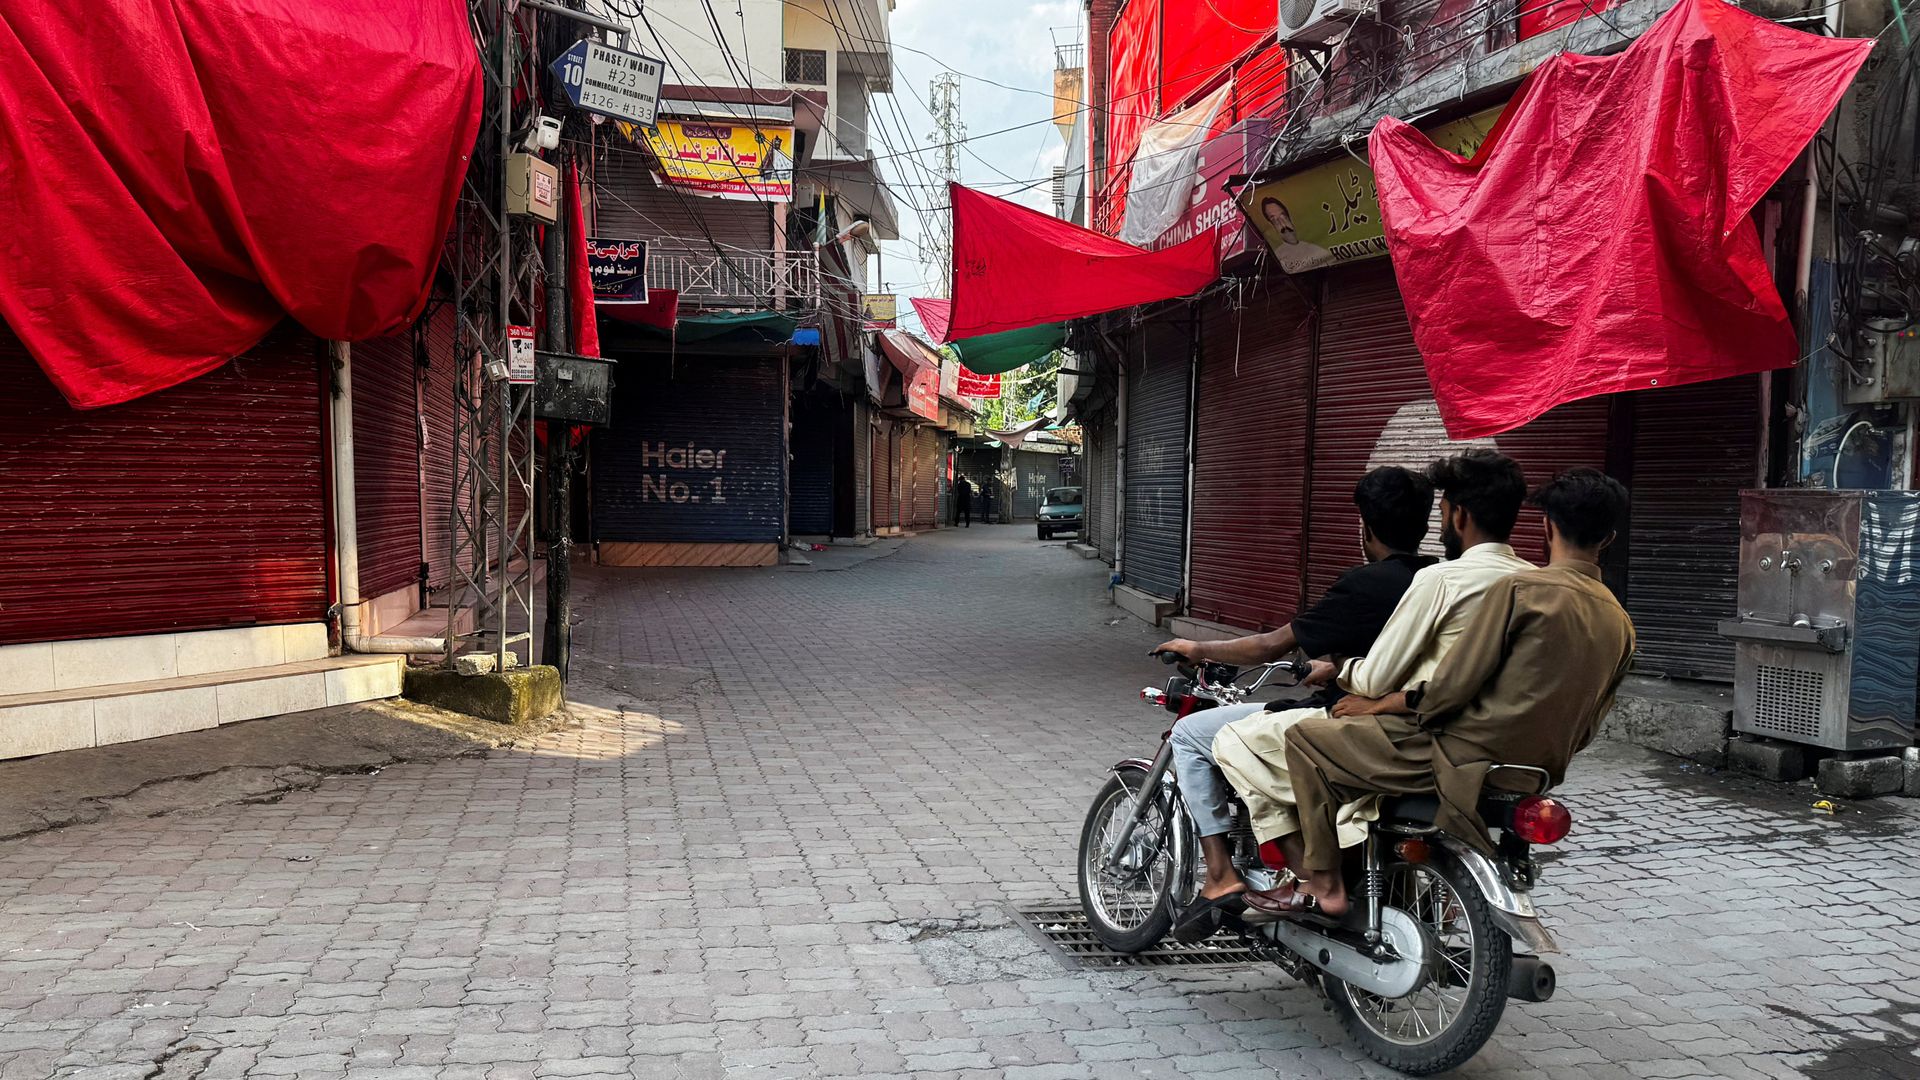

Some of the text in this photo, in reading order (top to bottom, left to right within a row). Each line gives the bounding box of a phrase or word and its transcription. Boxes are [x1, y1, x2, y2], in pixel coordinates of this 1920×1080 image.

[567, 53, 584, 65] STREET
[593, 49, 656, 76] PHASE / WARD
[563, 63, 583, 87] 10
[608, 68, 637, 87] #23
[584, 77, 619, 94] COMMERCIAL
[622, 88, 655, 104] RESIDENTIAL
[1159, 220, 1193, 250] CHINA
[1195, 197, 1237, 235] SHOES
[596, 242, 640, 262] کراچی
[1329, 239, 1374, 261] HOLLY
[594, 263, 615, 277] فوم
[641, 440, 727, 469] Haier
[641, 473, 727, 504] No. 1
